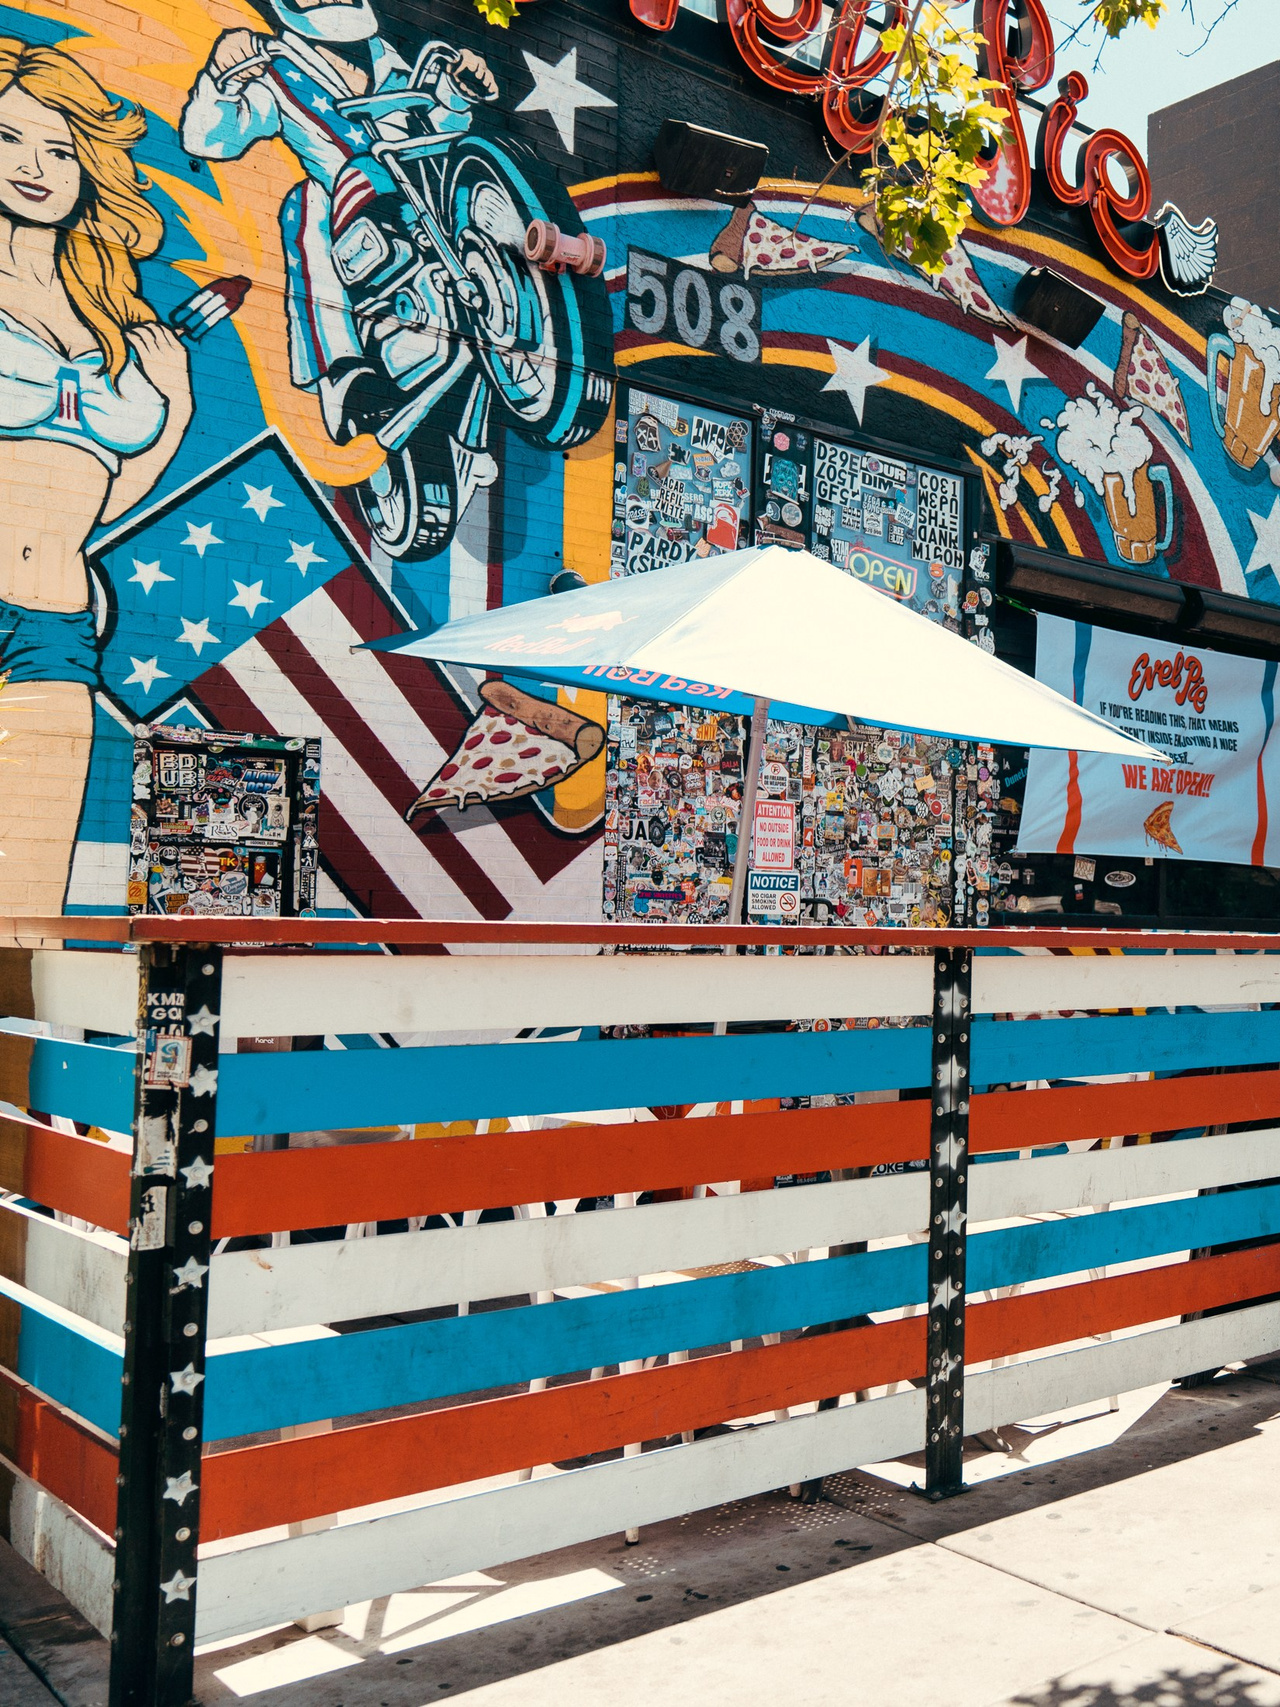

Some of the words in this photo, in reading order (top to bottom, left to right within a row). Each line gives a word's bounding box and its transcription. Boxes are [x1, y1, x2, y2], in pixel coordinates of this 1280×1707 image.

[628, 251, 760, 362] 508
[630, 532, 697, 562] PARDY
[850, 553, 911, 595] OPEN
[1128, 651, 1184, 700] Evel
[1175, 656, 1208, 714] Pie
[1100, 702, 1107, 716] IF
[1135, 708, 1168, 726] READING
[1188, 717, 1206, 731] THAT
[1208, 720, 1240, 733] MEANS
[1148, 731, 1174, 746] INSIDE
[1173, 734, 1212, 748] ENJOYING
[1212, 737, 1219, 750] A
[1220, 738, 1238, 752] NICE
[692, 759, 704, 767] TK
[1121, 764, 1148, 790] WE
[1151, 766, 1177, 794] ARE
[757, 803, 792, 818] ATTENTION
[759, 822, 768, 832] NO
[768, 823, 789, 834] OUTSIDE
[757, 837, 769, 847] FOOD
[769, 837, 777, 847] OR
[777, 838, 791, 848] DRINK
[219, 857, 236, 867] TK
[762, 851, 785, 863] ALLOWED
[752, 875, 797, 890] NOTICE
